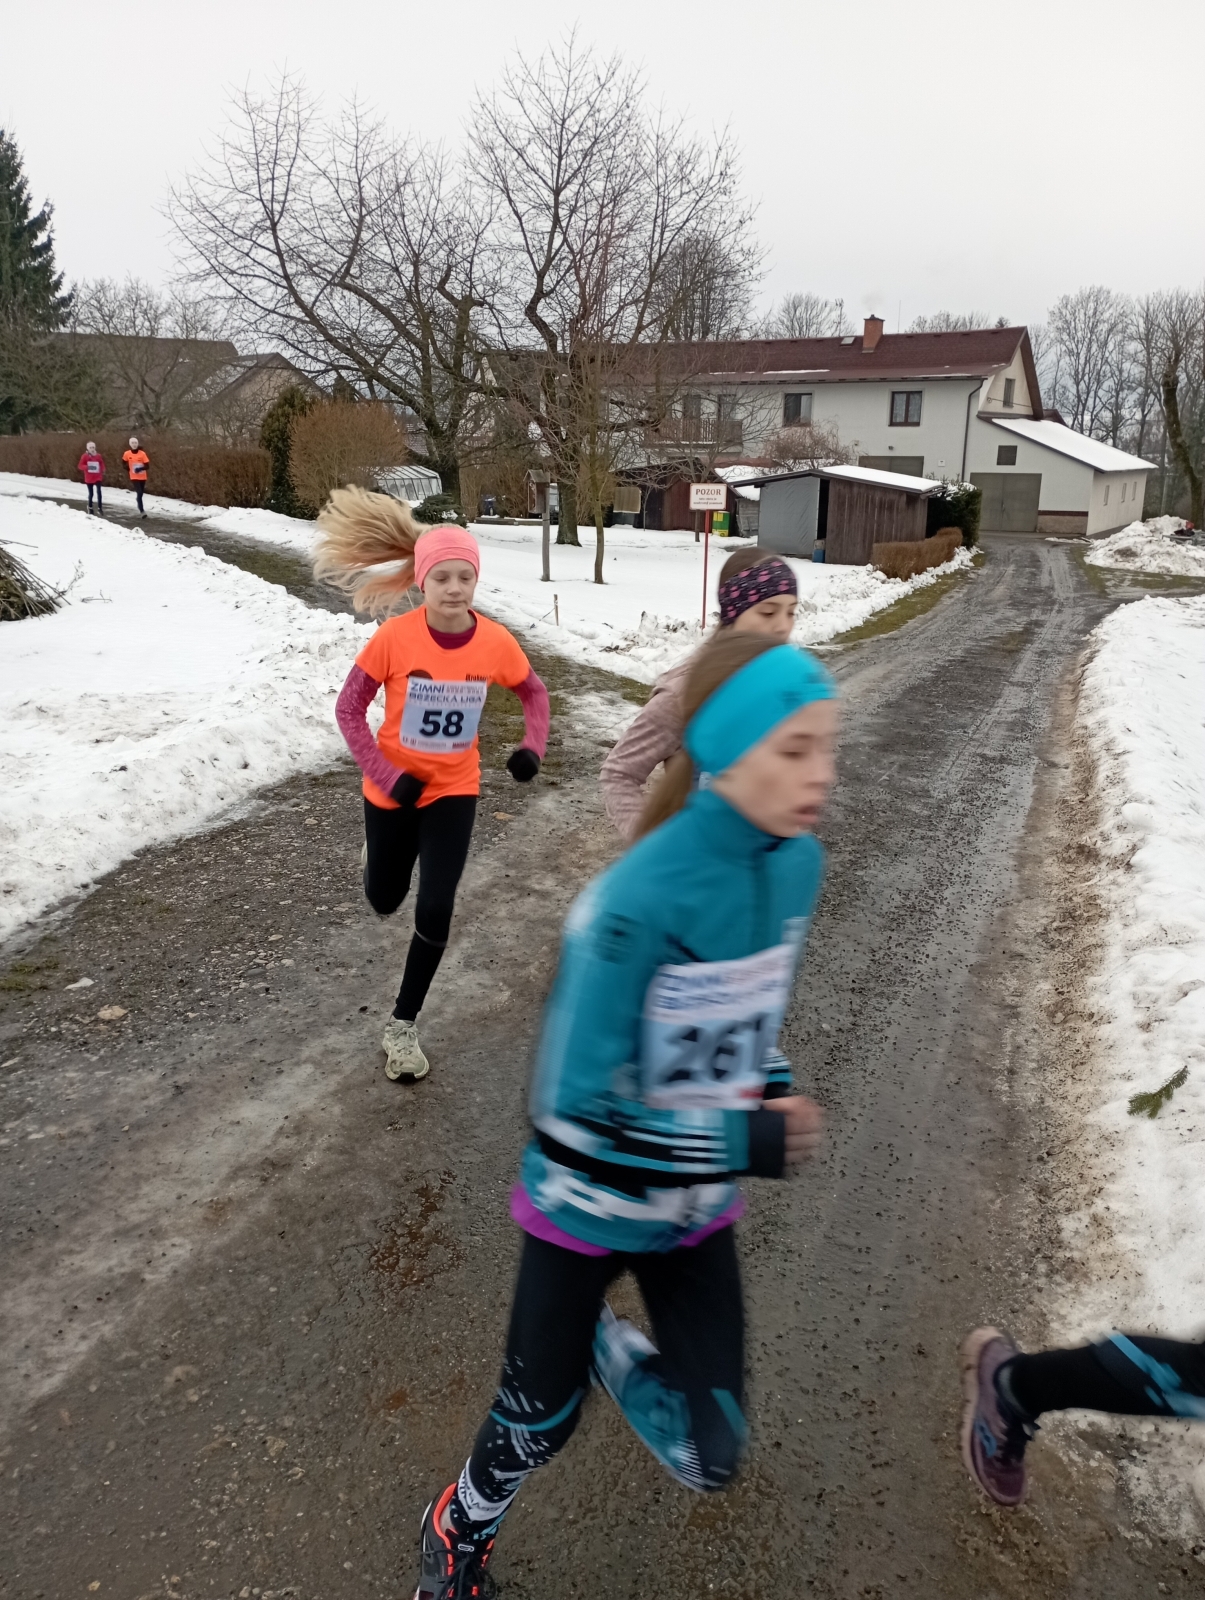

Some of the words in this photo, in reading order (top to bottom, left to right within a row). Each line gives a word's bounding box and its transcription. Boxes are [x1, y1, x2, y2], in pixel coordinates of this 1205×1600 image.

[410, 682, 445, 694] ZIMNÍ
[460, 695, 482, 704] LIGA
[419, 709, 465, 737] 58
